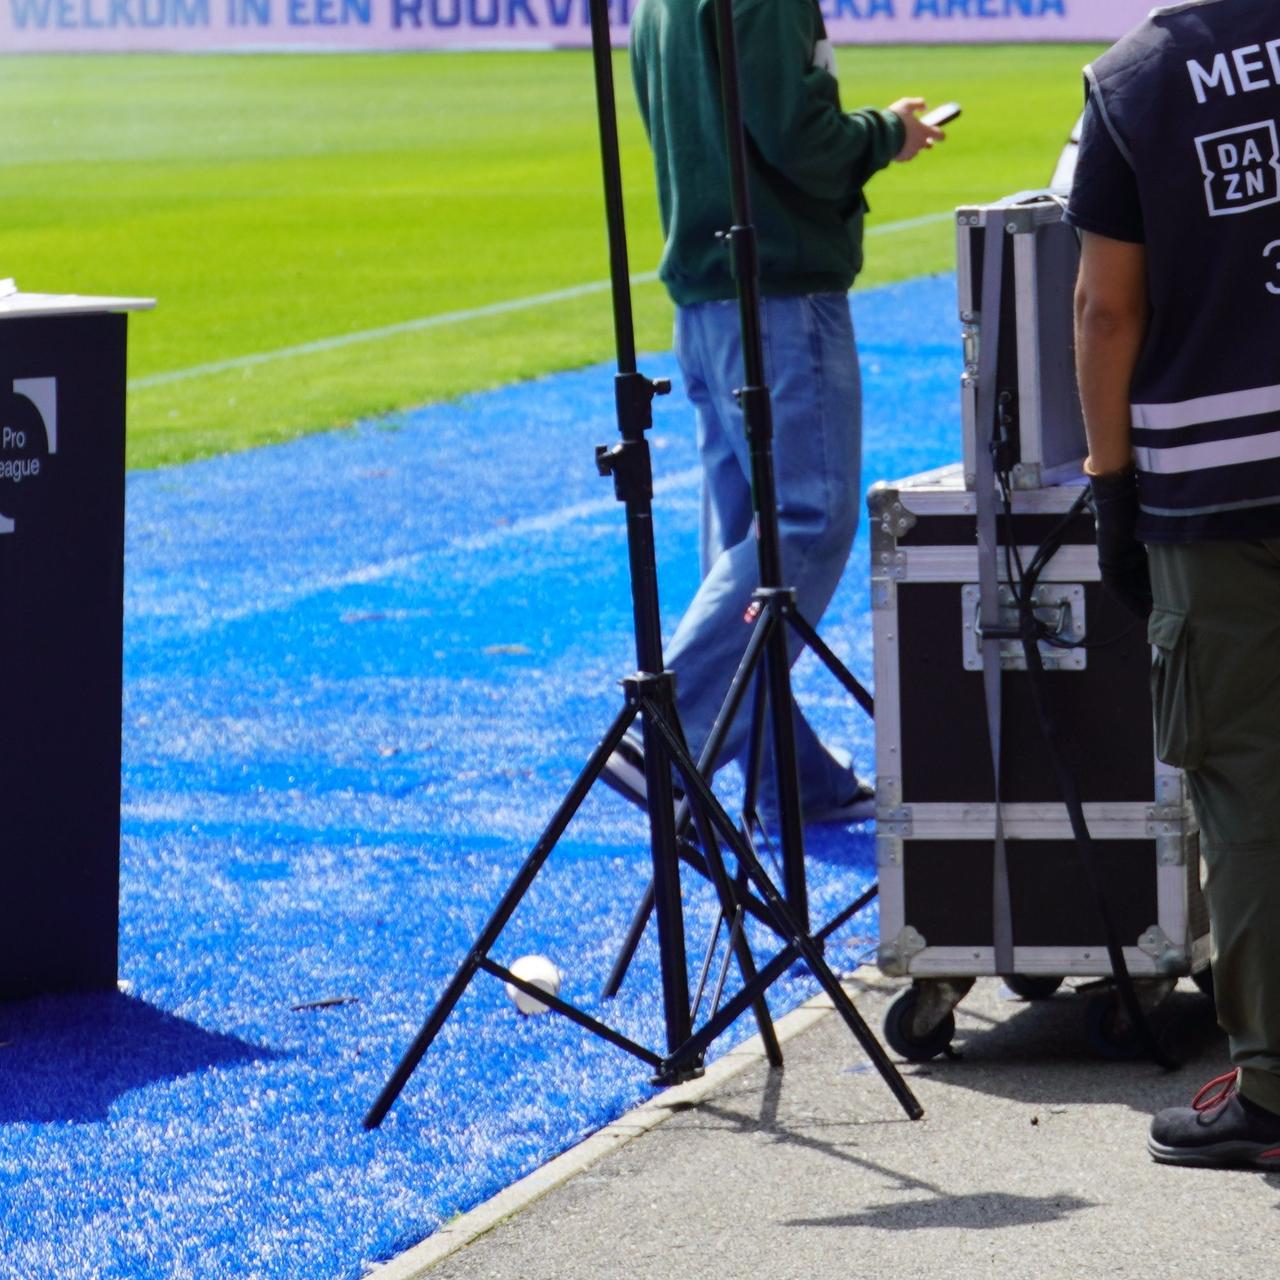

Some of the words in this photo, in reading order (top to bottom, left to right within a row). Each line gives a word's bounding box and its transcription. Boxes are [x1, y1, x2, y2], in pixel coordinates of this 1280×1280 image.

[1217, 138, 1262, 169] DA
[1223, 168, 1265, 201] ZN
[2, 426, 25, 448] Pro
